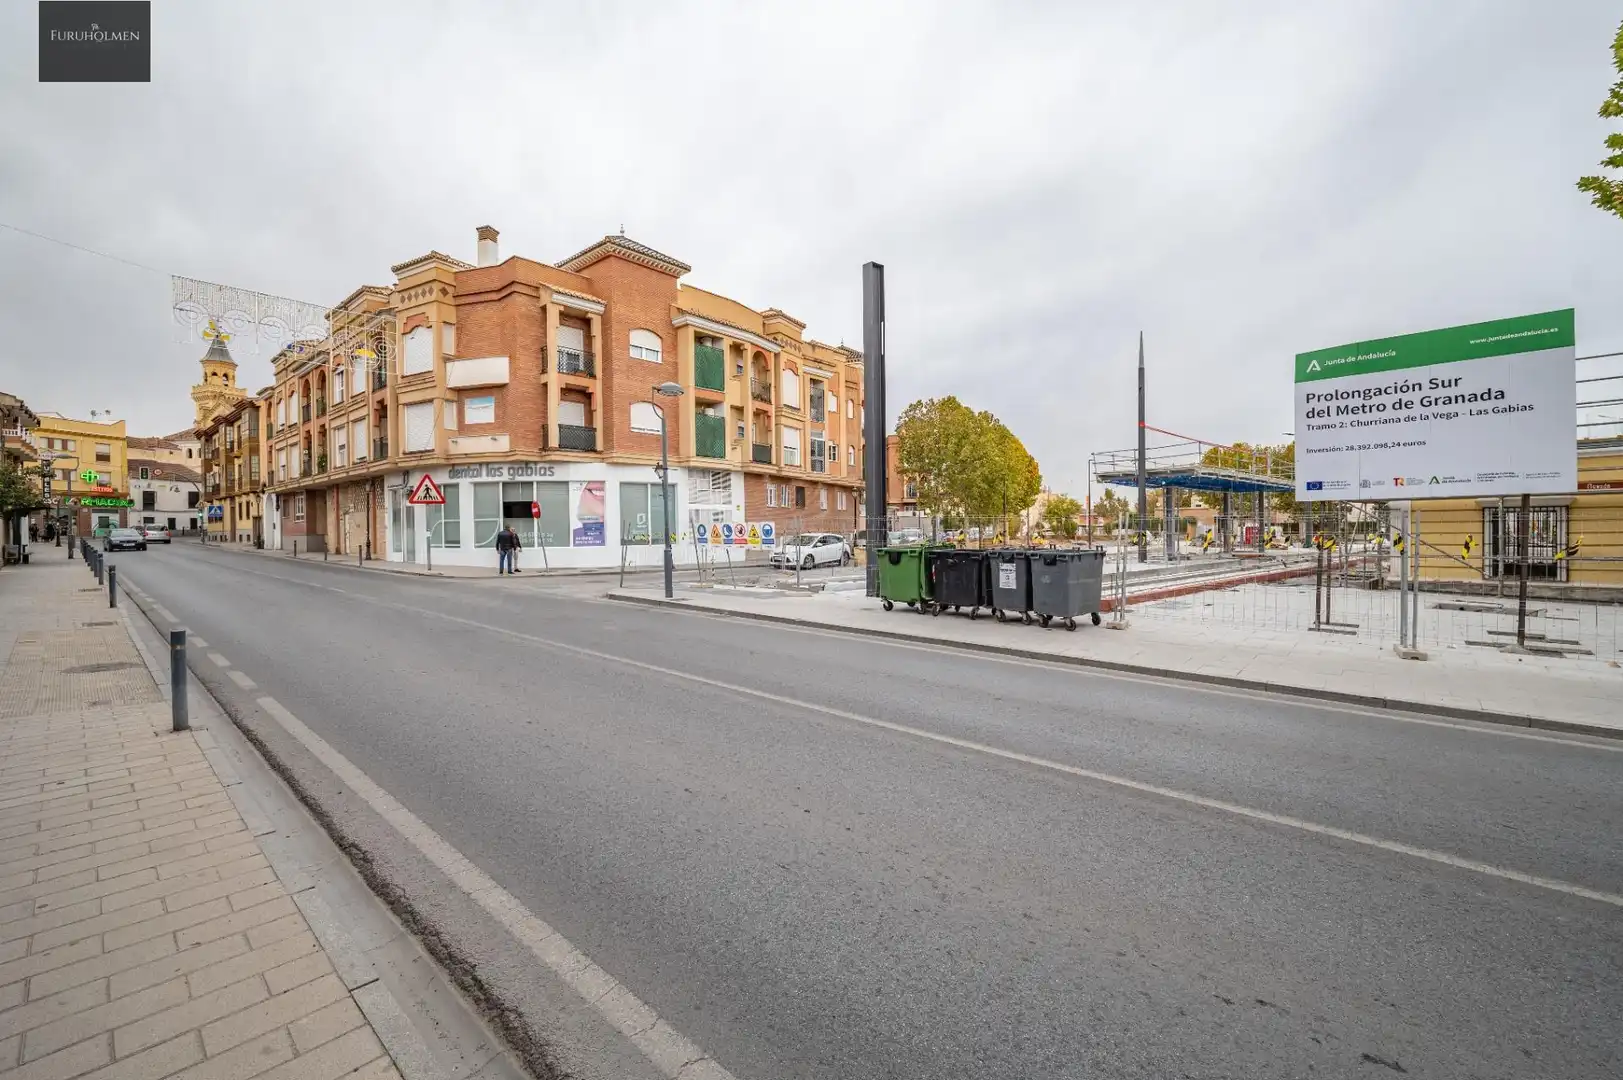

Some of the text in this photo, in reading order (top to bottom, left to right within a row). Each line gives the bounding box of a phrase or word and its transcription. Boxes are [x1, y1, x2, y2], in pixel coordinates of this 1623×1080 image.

[1469, 327, 1559, 344] www.juntadeandalucia.es
[1323, 357, 1345, 366] Junta
[1357, 349, 1396, 361] Andalucía
[1306, 376, 1463, 404] Prolongación Sur
[1306, 387, 1506, 419] del Metro de Granada
[1306, 423, 1337, 431] Tramo
[1339, 421, 1348, 429] 2:
[1350, 417, 1401, 428] Churriana
[1403, 414, 1417, 423] de
[1420, 413, 1430, 421] la
[1431, 410, 1459, 421] Vega
[1469, 408, 1489, 416] Las
[1492, 403, 1535, 414] Gabias
[1306, 445, 1344, 454] Inversión:
[448, 461, 555, 480] dental las gabias
